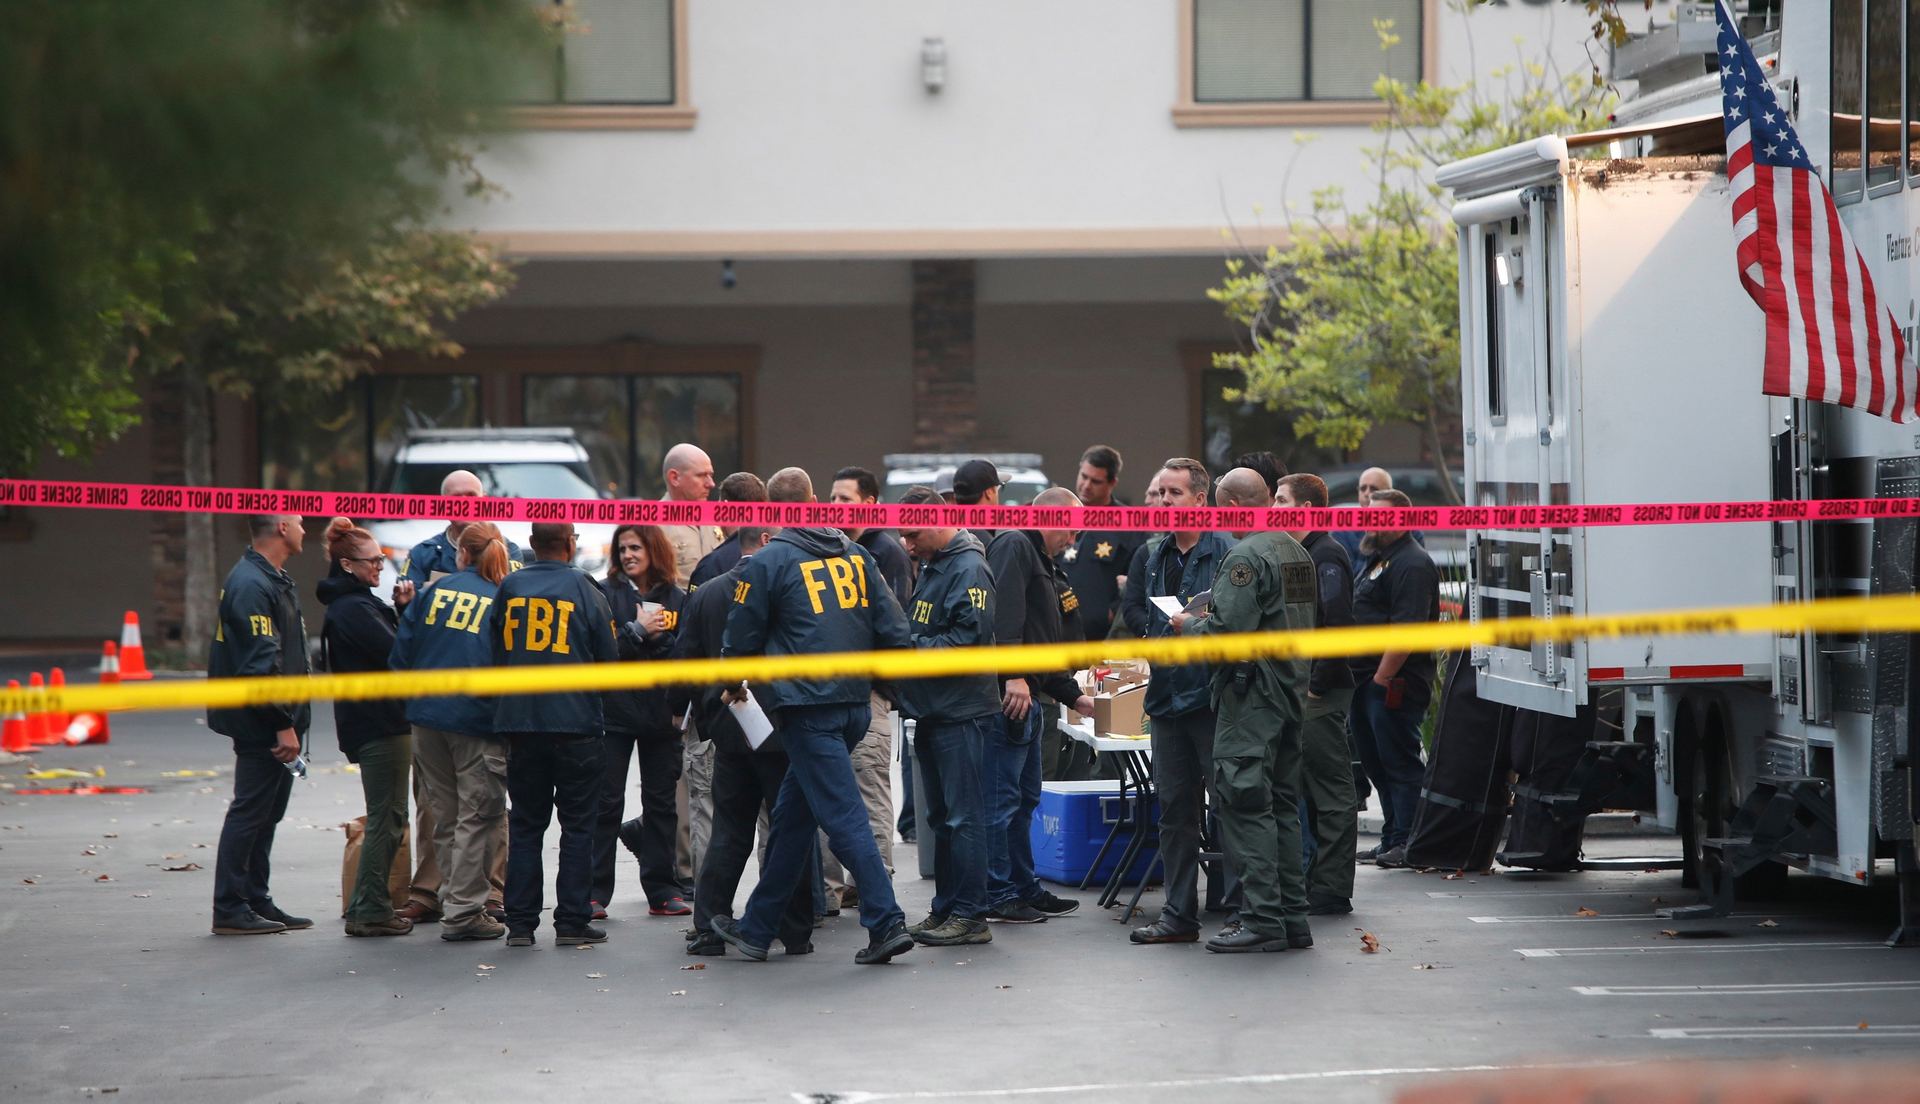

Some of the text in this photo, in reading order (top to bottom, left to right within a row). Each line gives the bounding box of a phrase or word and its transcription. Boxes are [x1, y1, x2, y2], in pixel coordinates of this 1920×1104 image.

[734, 580, 751, 604] BI
[800, 555, 869, 615] FBI
[425, 588, 494, 634] FBI
[663, 609, 679, 631] BI
[912, 600, 934, 625] FBI
[249, 614, 273, 637] FBI
[503, 597, 575, 654] FBI
